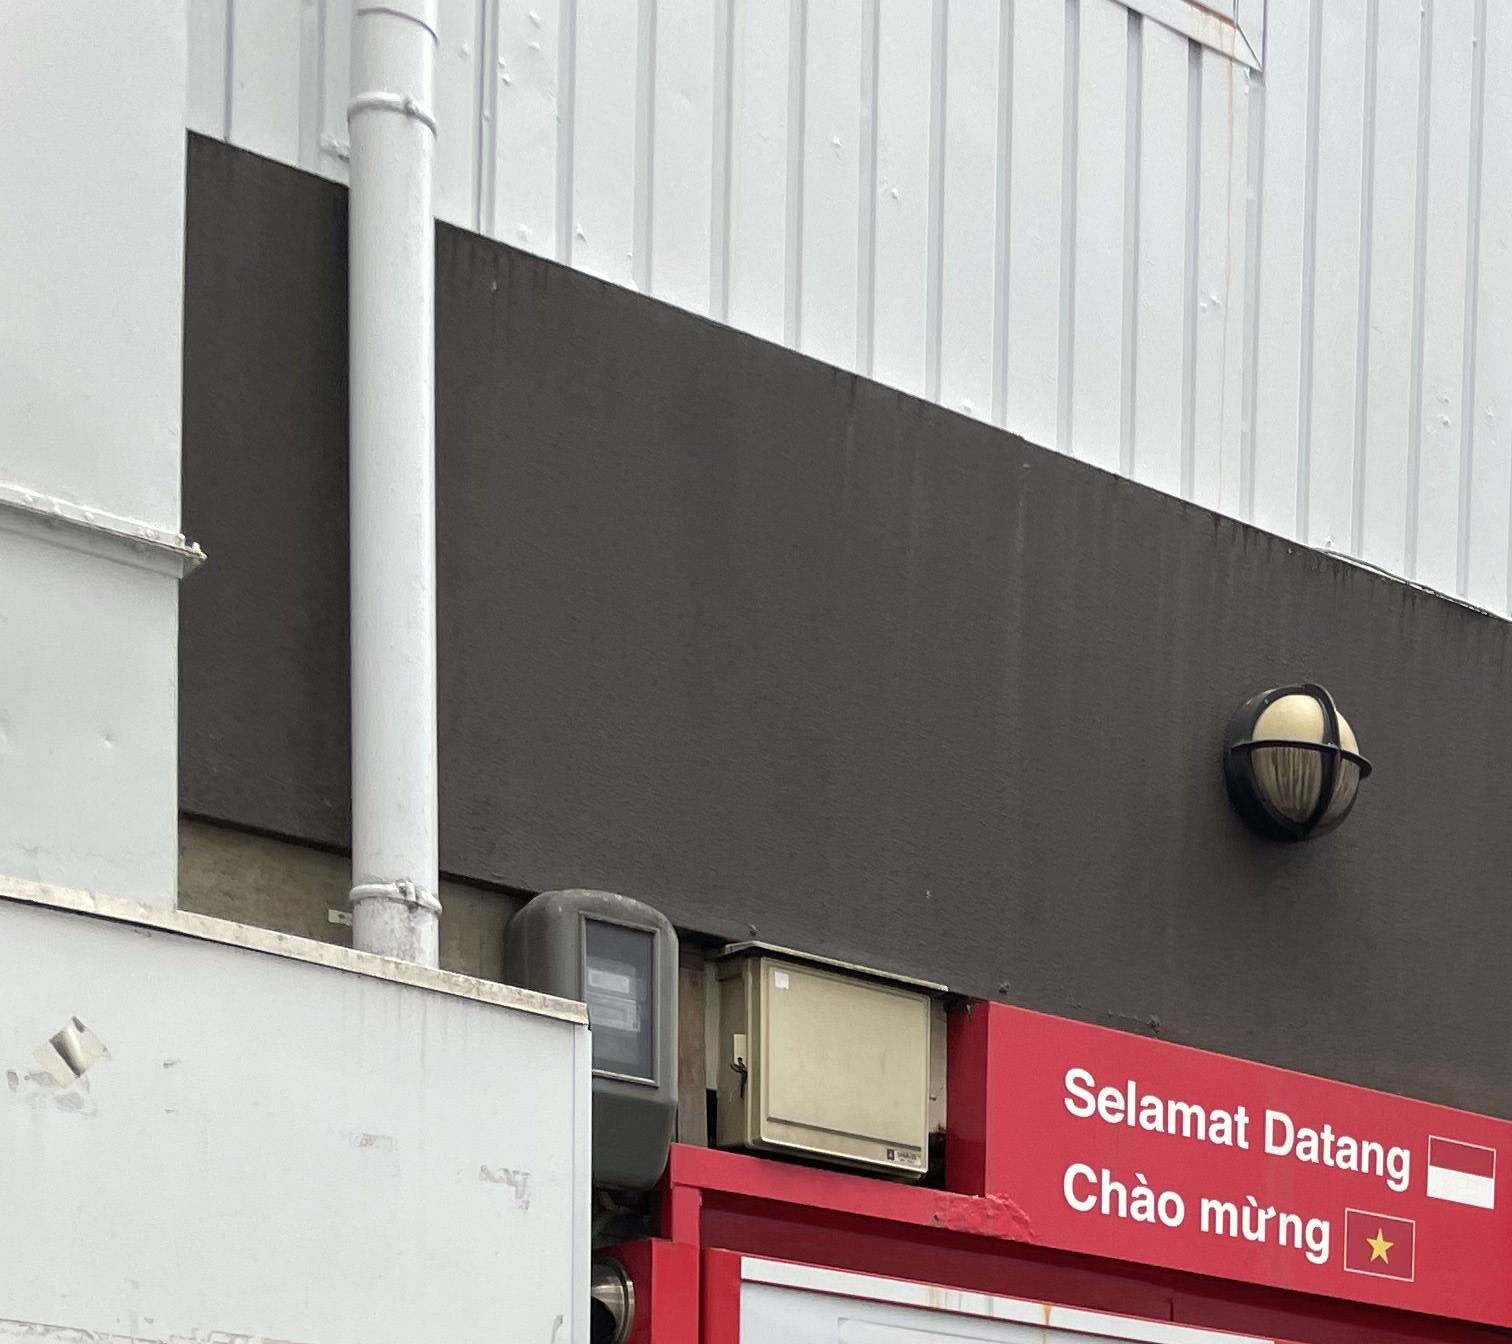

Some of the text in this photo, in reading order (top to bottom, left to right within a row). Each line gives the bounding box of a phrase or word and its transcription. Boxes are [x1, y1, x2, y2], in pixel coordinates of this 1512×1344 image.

[1064, 1068, 1412, 1193] Selamat Datang
[1063, 1163, 1331, 1265] Chào mừng
